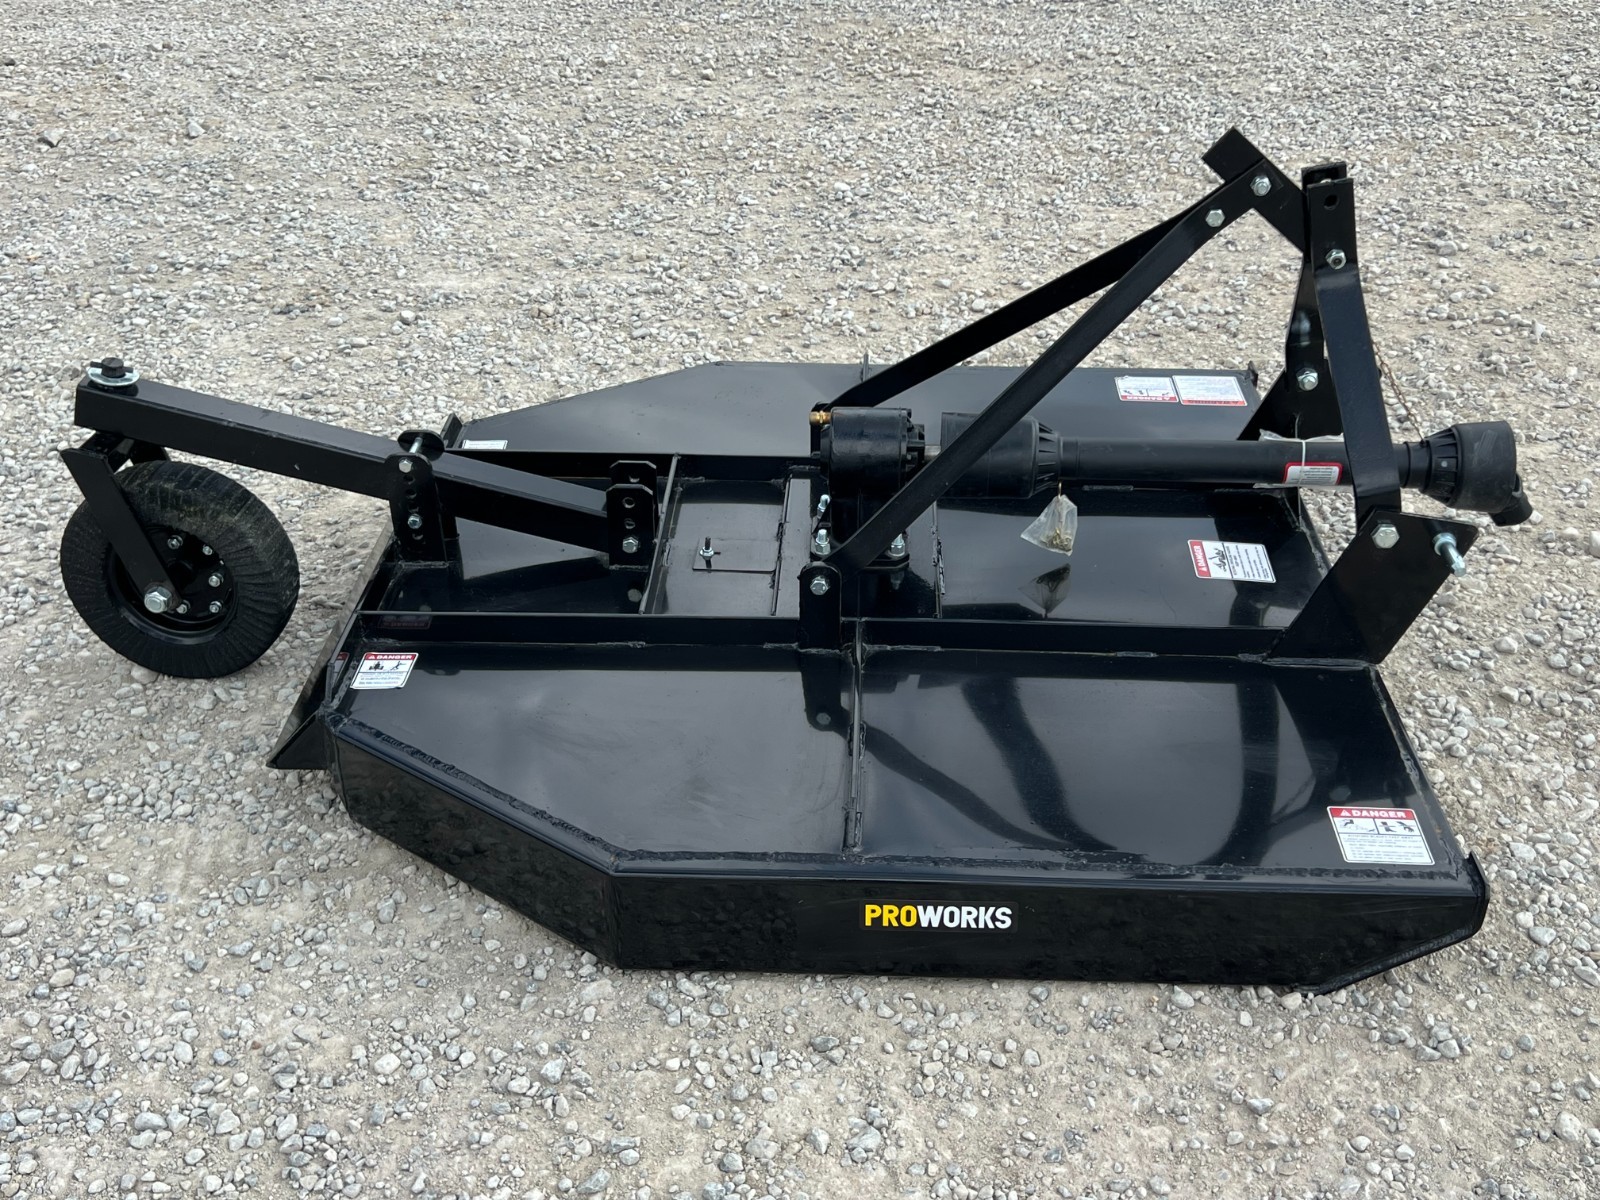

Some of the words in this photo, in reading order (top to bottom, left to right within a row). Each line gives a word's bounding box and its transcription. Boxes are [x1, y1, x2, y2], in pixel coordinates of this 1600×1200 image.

[1193, 546, 1208, 568] DANGER
[1351, 810, 1406, 818] DANGER
[865, 904, 1012, 929] PROWORKS
